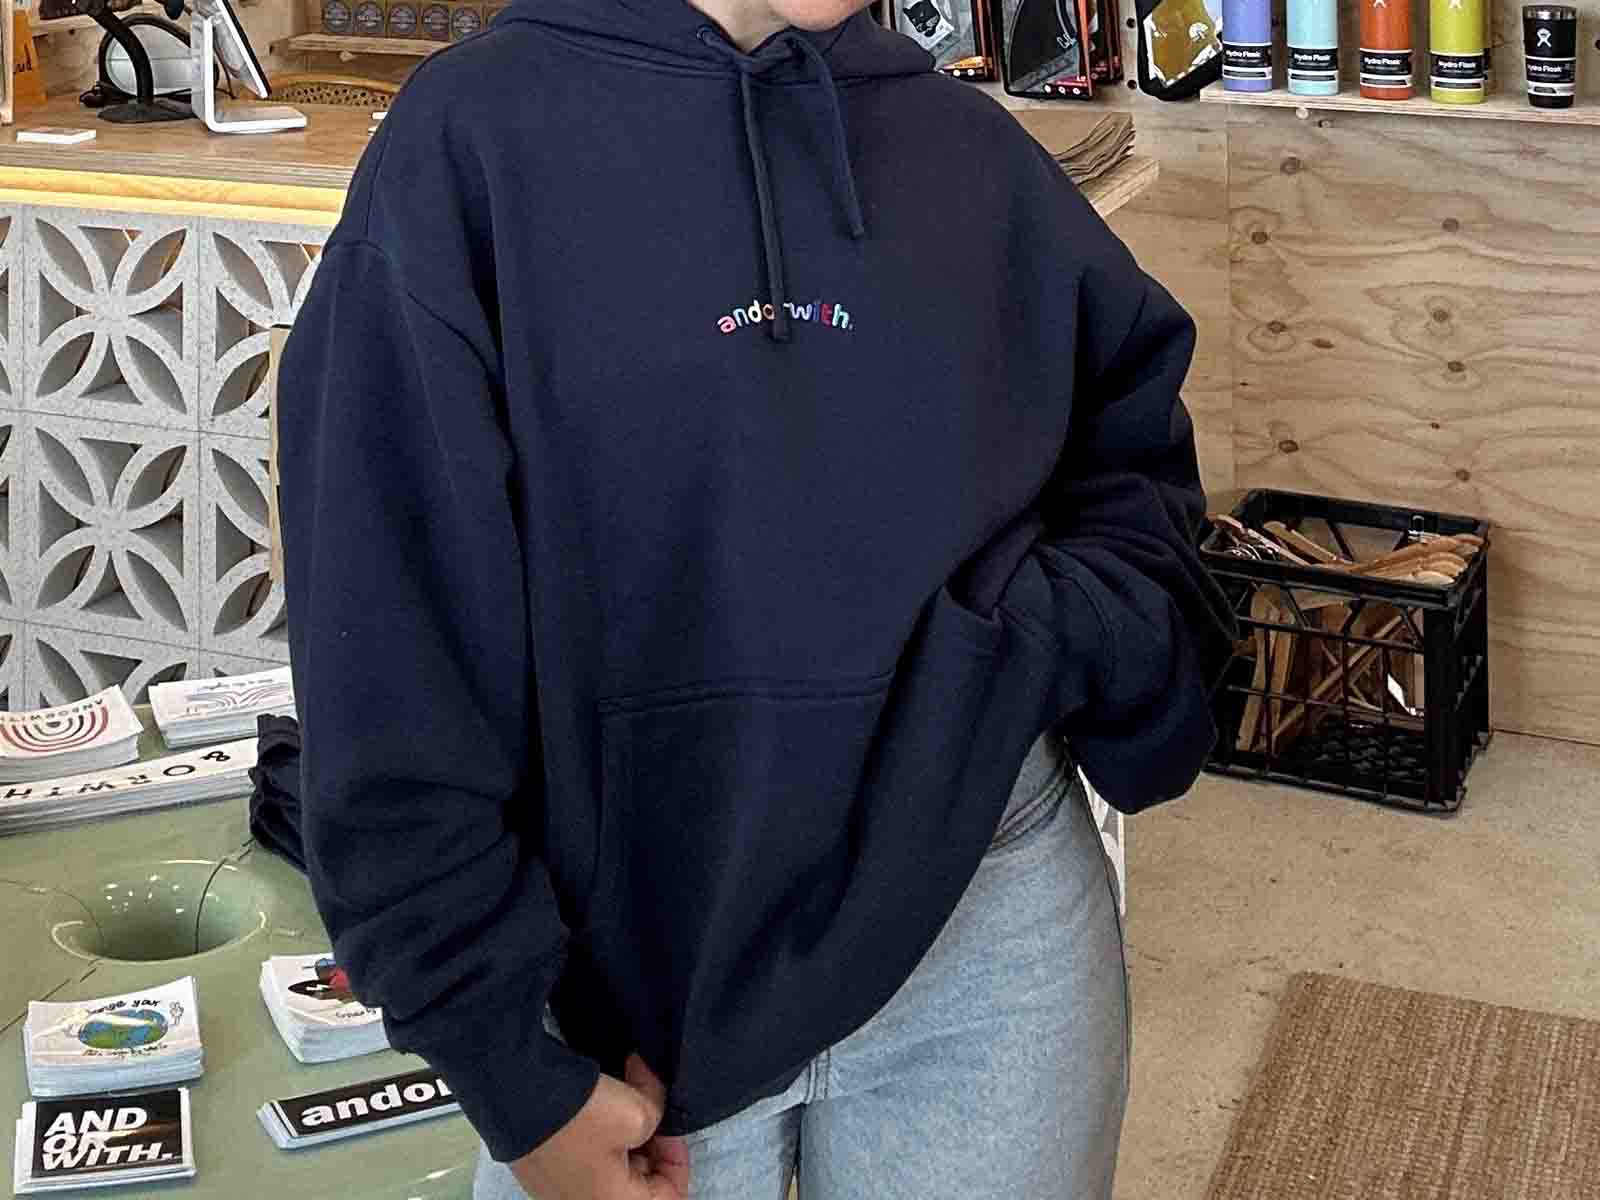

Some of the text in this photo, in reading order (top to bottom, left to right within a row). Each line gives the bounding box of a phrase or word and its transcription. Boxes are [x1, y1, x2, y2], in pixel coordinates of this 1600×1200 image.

[717, 299, 854, 334] andowith.
[44, 1107, 148, 1138] AND
[42, 1142, 174, 1171] WITH.
